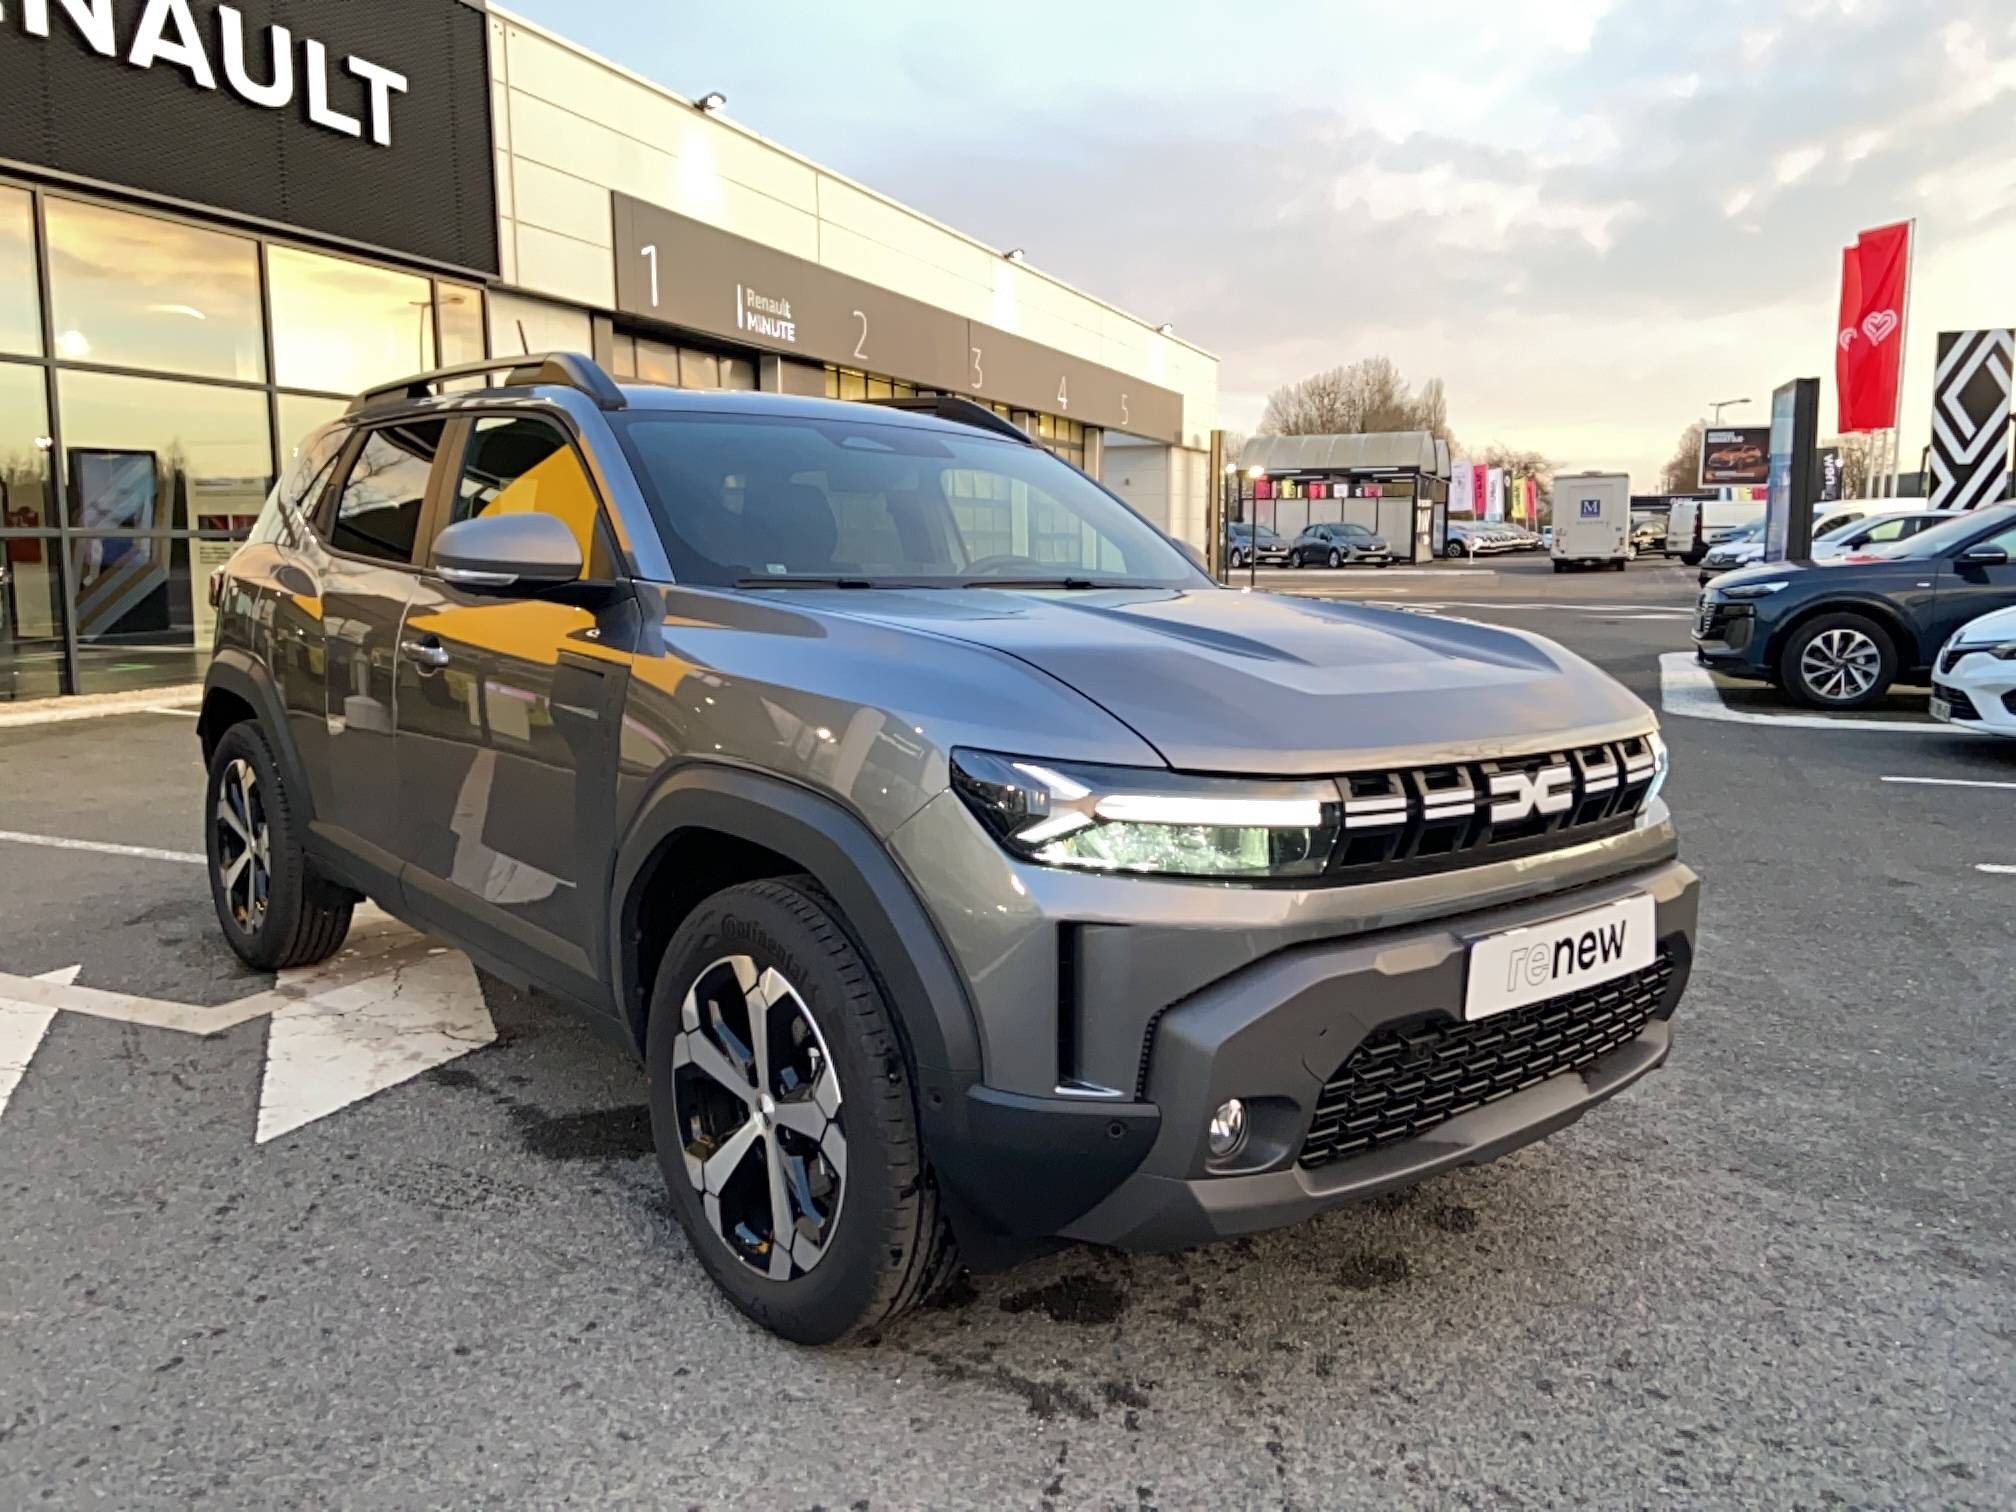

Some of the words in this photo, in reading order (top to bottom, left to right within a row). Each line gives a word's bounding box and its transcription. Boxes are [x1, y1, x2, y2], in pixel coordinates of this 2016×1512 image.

[0, 0, 407, 146] NAULT
[640, 245, 658, 307] 1
[746, 287, 791, 319] Renault
[747, 311, 795, 342] MINUTE
[853, 310, 868, 359] 2
[971, 347, 983, 389] 3
[1057, 375, 1067, 410] 4
[1121, 393, 1129, 425] 5
[1583, 501, 1598, 513] M
[1506, 919, 1626, 993] renew
